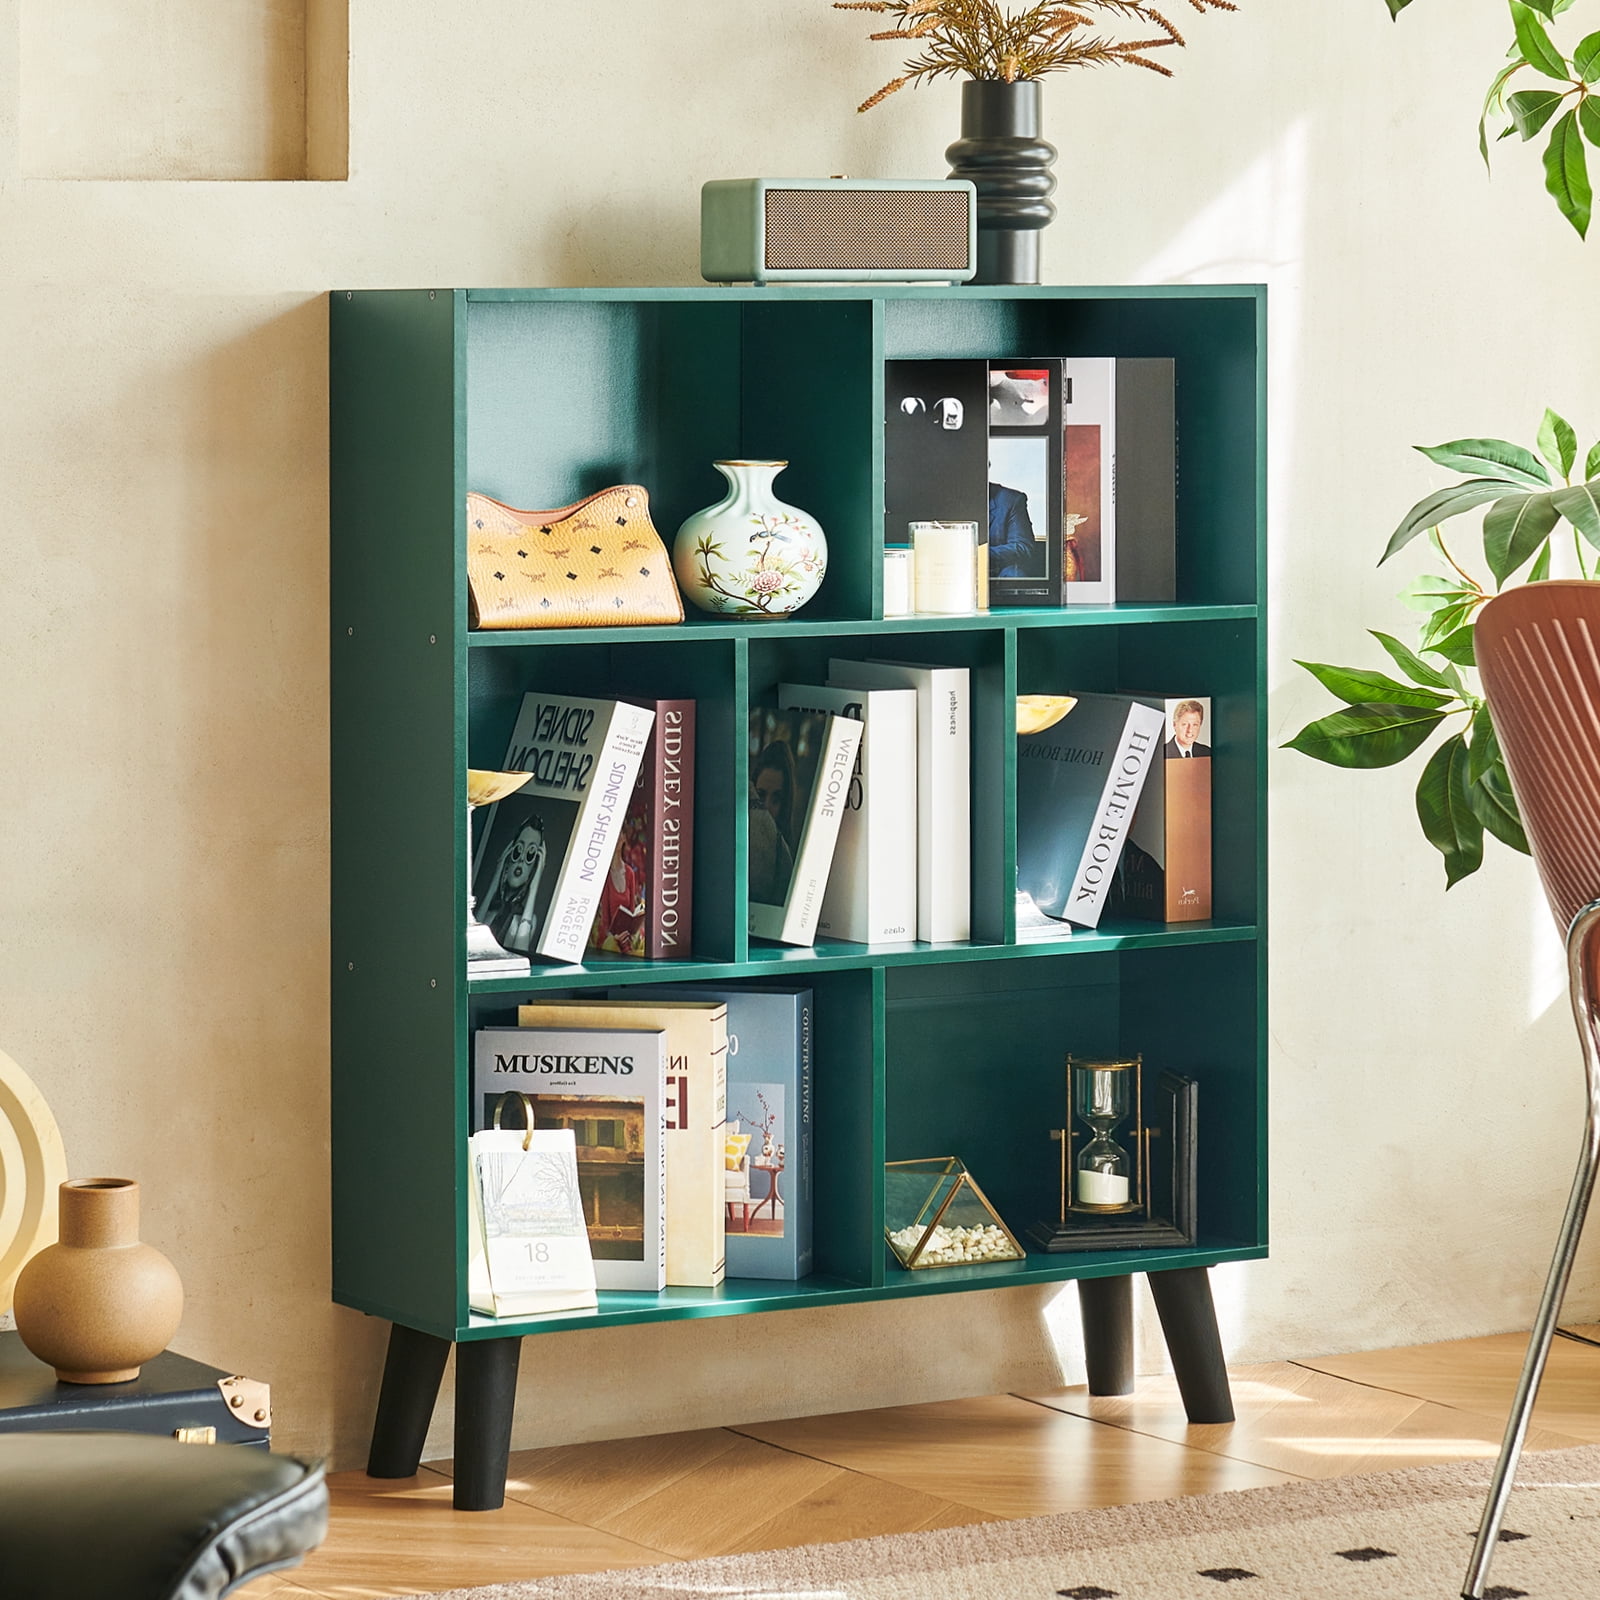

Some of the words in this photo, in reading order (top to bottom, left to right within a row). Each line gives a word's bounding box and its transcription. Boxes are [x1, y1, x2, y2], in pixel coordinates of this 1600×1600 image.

[600, 761, 627, 815] SIDNEY
[820, 737, 852, 818] WELCOME
[1106, 731, 1151, 819] HOME
[579, 812, 611, 882] SHELDON
[1076, 825, 1119, 903] BOOK
[556, 896, 575, 946] ANGELS
[493, 1054, 634, 1076] MUSIKENS
[802, 1075, 810, 1124] LIVING
[524, 1242, 550, 1263] 18
